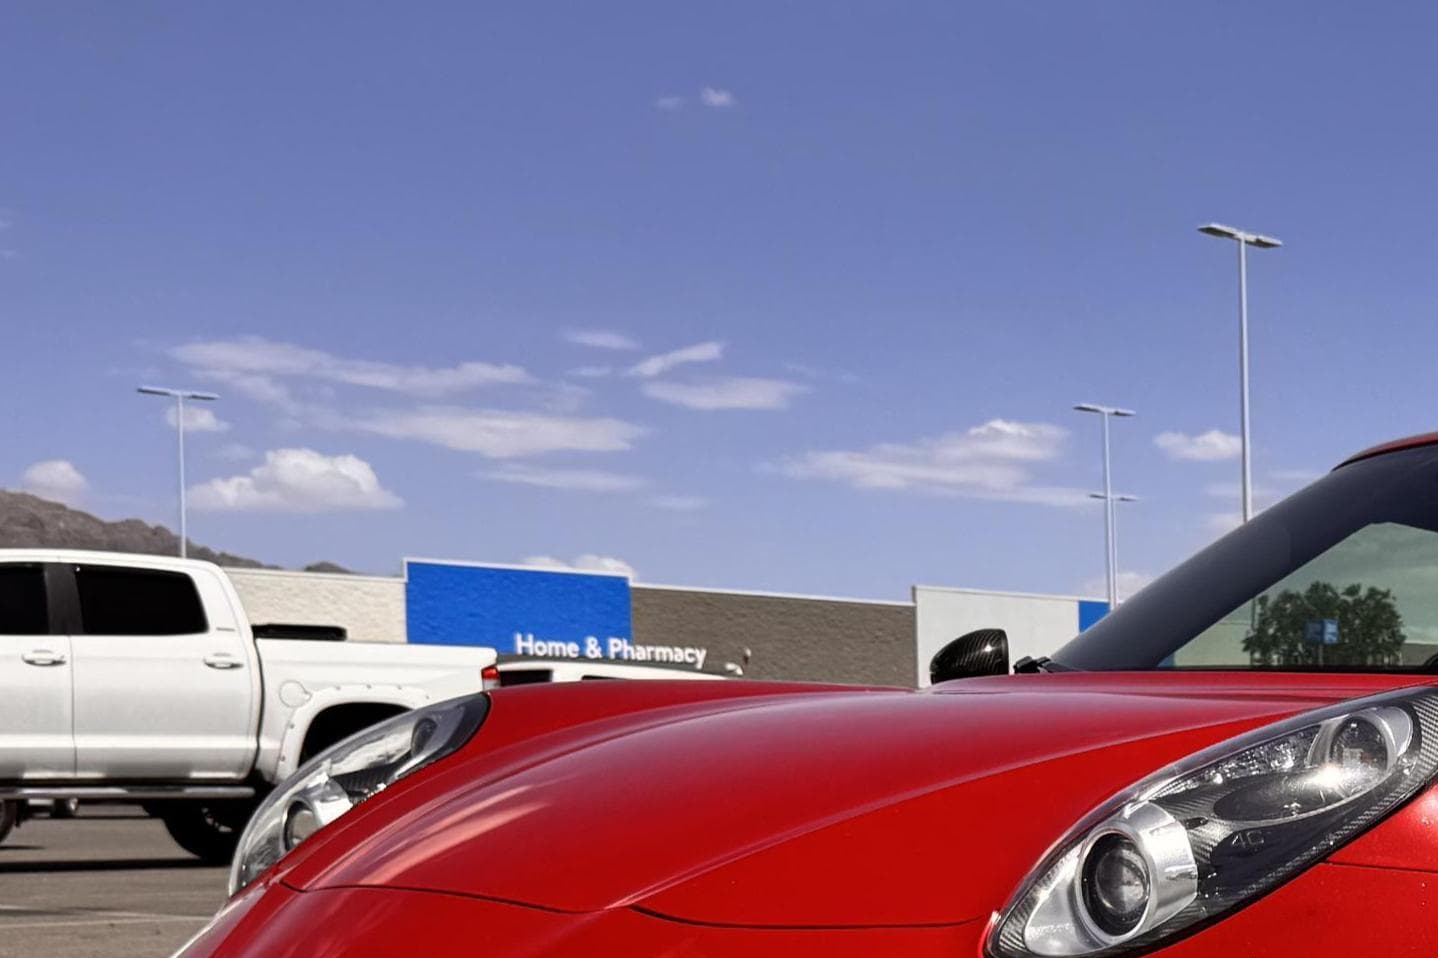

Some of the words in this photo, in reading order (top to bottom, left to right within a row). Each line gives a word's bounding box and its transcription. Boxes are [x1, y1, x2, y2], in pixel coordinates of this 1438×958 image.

[514, 633, 580, 658] Home
[584, 636, 603, 660] &
[607, 637, 707, 669] Pharmacy
